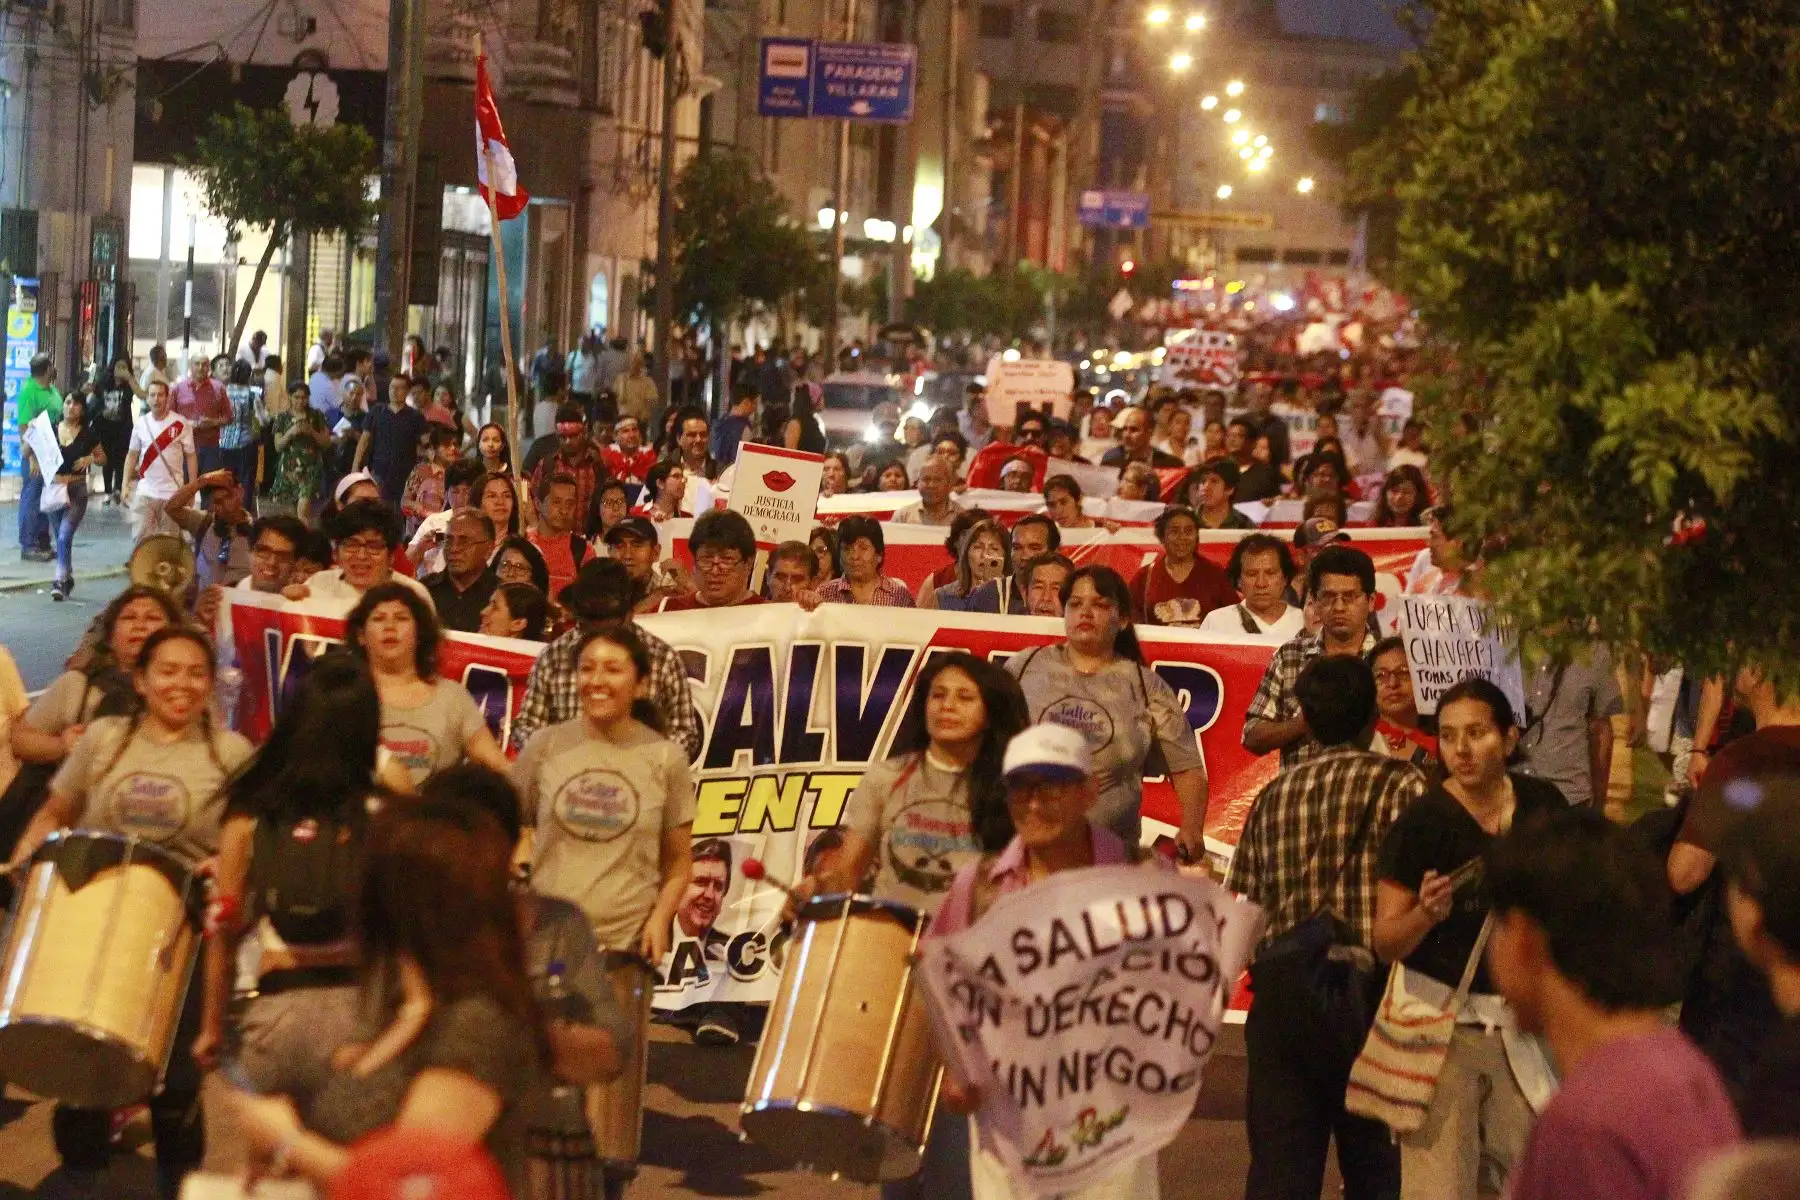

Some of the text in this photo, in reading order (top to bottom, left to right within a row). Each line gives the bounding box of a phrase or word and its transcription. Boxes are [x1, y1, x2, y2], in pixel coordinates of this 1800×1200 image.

[754, 495, 794, 511] JUSTICIA
[743, 505, 801, 523] DEMOCRACIA
[1417, 669, 1454, 685] TOMAS
[1060, 703, 1097, 721] Taller
[1010, 892, 1194, 976] SALUD
